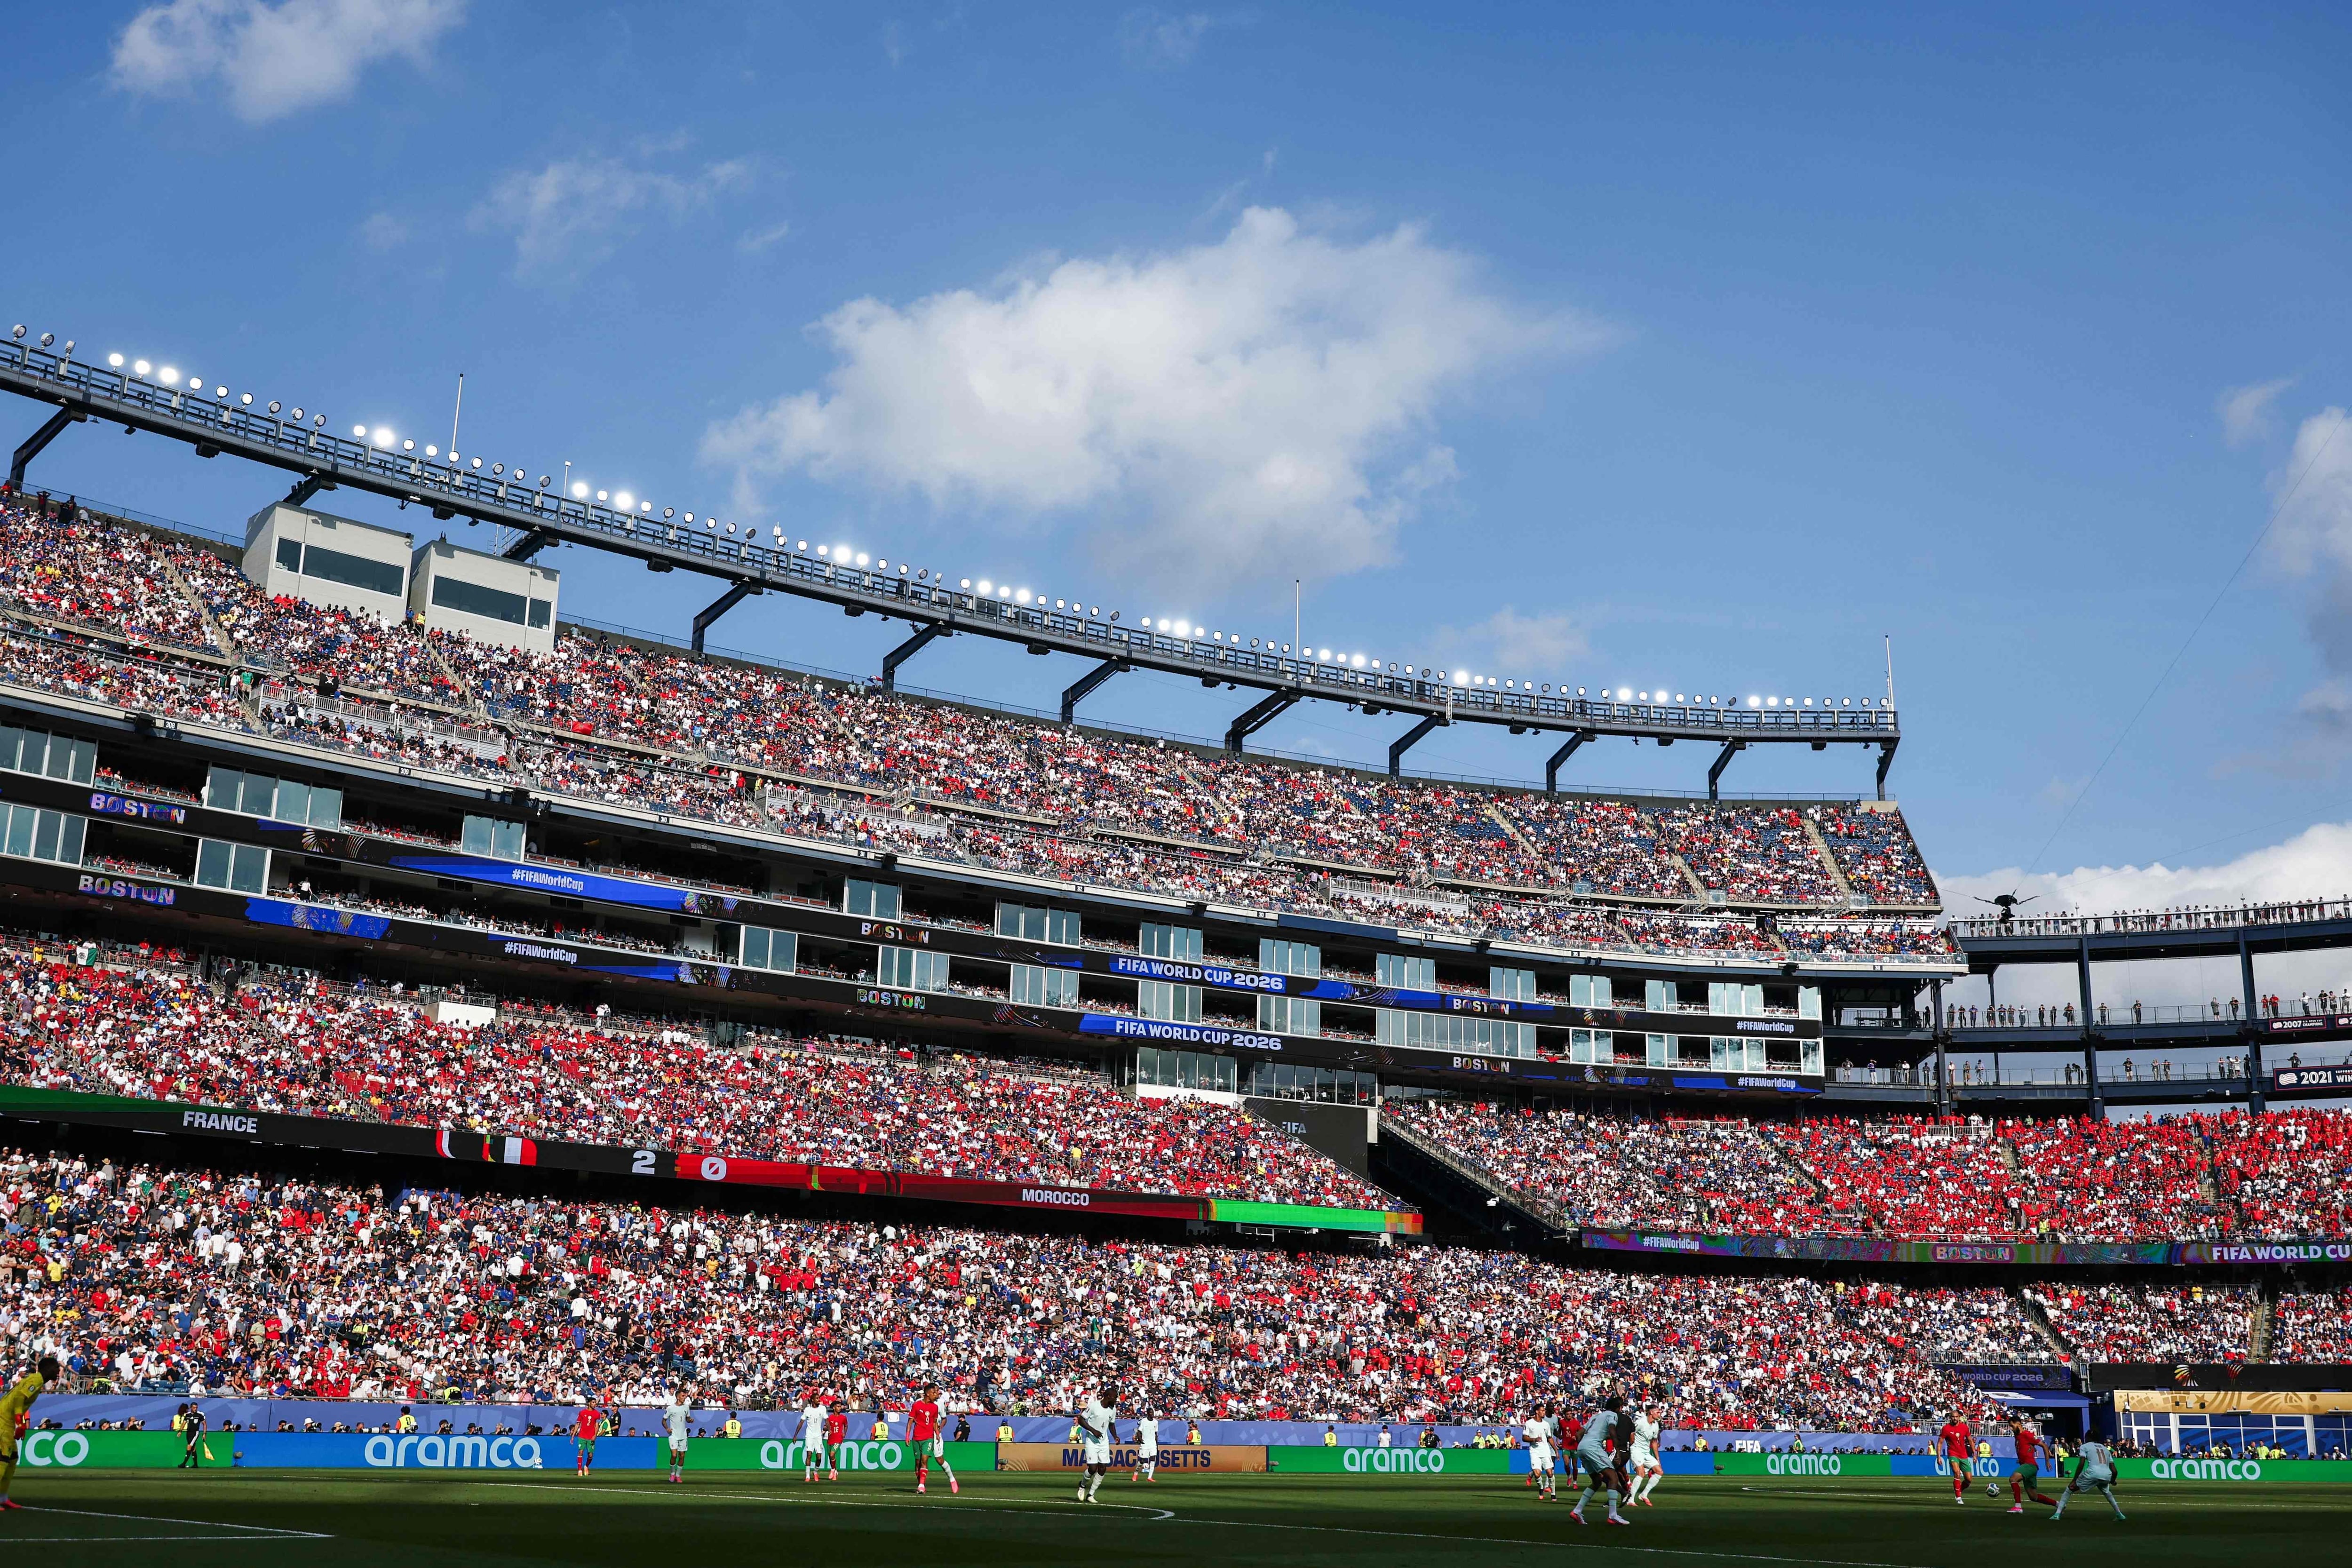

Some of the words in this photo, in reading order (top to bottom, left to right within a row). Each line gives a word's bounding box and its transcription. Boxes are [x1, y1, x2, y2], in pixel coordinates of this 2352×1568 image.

[79, 875, 175, 904] BOSTON
[512, 868, 584, 892] #FIFAWorldCup
[504, 941, 577, 964] #FIFAWorldCup
[1118, 957, 1150, 973] FIFA
[1151, 962, 1202, 980] WORLD
[1204, 969, 1232, 983] CUP
[1234, 973, 1283, 990] 2026
[857, 989, 926, 1010] BOSTON
[1736, 1020, 1794, 1034] #FIFAWorldCup
[2283, 1020, 2302, 1028] 2007
[1116, 1020, 1147, 1036] FIFA
[1149, 1024, 1200, 1042] WORLD
[1202, 1030, 1231, 1044] CUP
[1232, 1034, 1282, 1050] 2026
[1453, 1057, 1510, 1073] BOSTON
[1738, 1077, 1796, 1089] #FIFAWorldCup
[2300, 1071, 2333, 1084] 2021
[183, 1110, 258, 1133] FRANCE
[632, 1150, 656, 1174] 2
[1022, 1188, 1089, 1206] MOROCCO
[1643, 1236, 1700, 1251] #FIFAWorldCup
[1936, 1246, 2010, 1260] BOSTON
[2212, 1247, 2252, 1260] FIFA
[2254, 1245, 2322, 1259] WORLD
[1962, 1372, 1992, 1381] WORLD
[365, 1435, 540, 1467] aramco
[1735, 1440, 1761, 1453] FIFA
[1343, 1448, 1444, 1472] aramco
[1766, 1454, 1841, 1475] aramco
[2151, 1459, 2261, 1480] aramco
